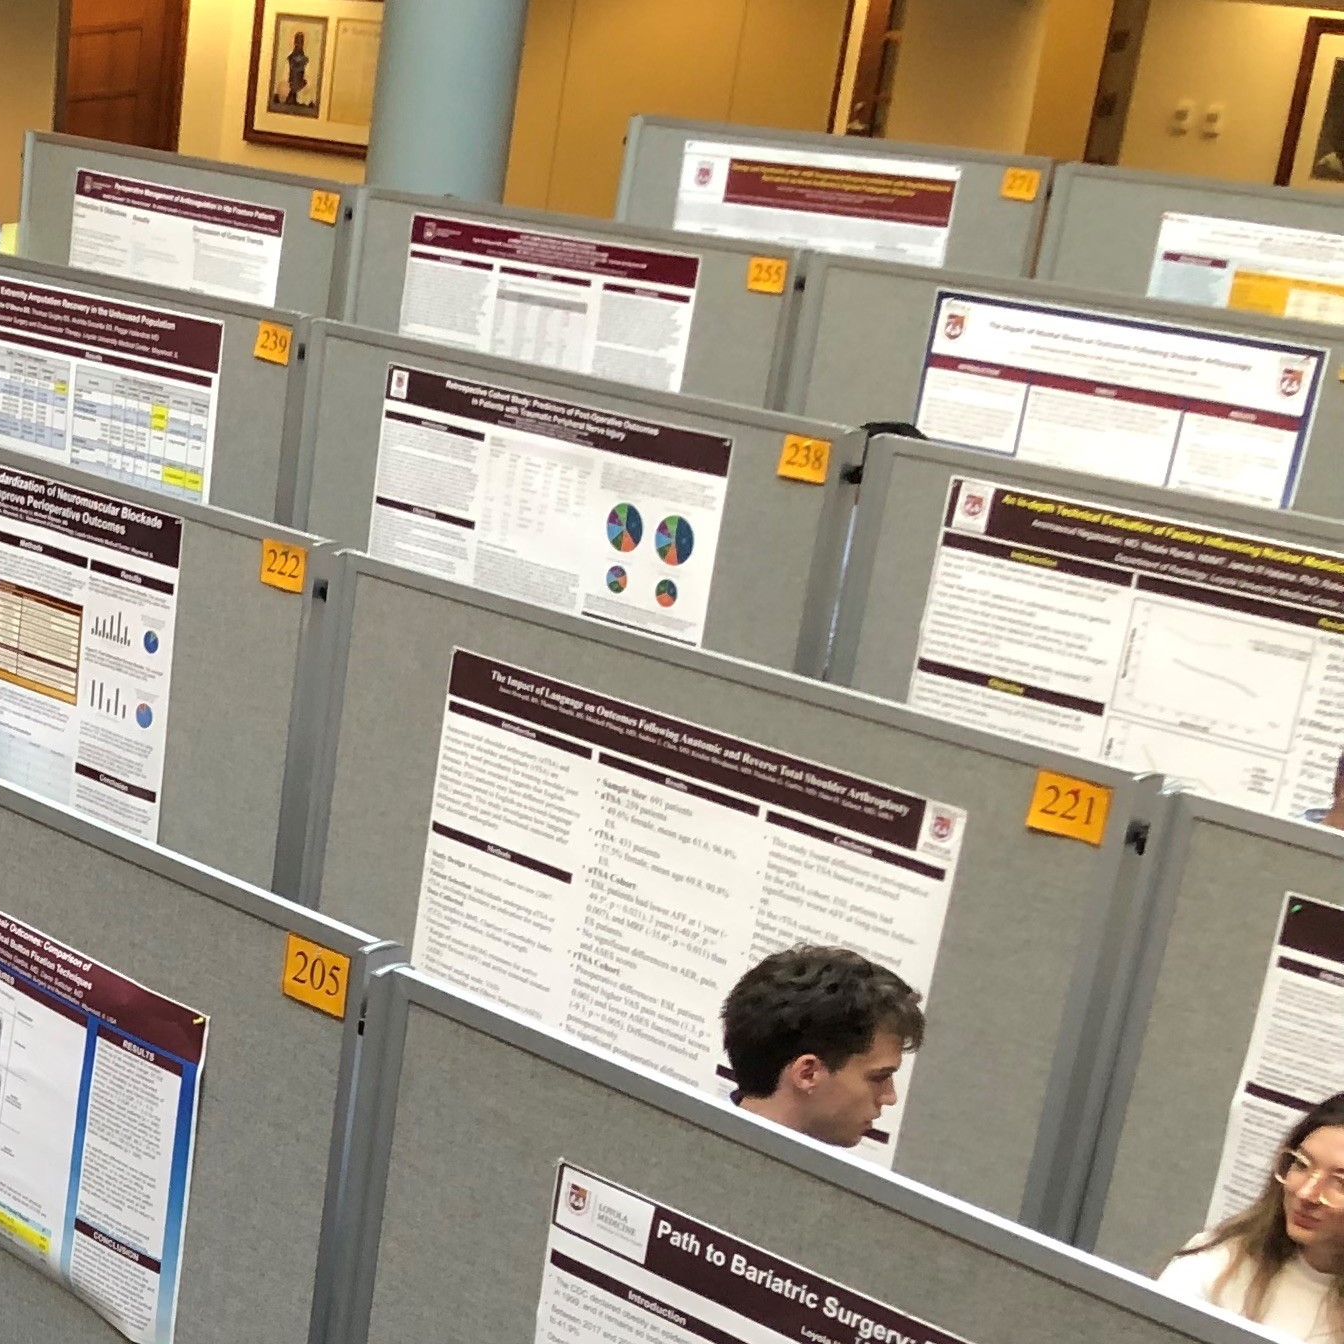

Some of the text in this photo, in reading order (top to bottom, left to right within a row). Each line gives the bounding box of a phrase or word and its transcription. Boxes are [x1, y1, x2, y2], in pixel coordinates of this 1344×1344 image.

[754, 263, 782, 283] 255
[0, 286, 27, 301] Extremity
[28, 292, 61, 306] Amputation
[62, 299, 90, 314] Recovery
[97, 306, 107, 316] the
[141, 315, 175, 330] Population
[260, 331, 287, 353] 239
[478, 398, 504, 411] Patients
[505, 405, 519, 414] with
[520, 407, 552, 422] Traumatic
[552, 414, 585, 430] Peripheral
[585, 423, 605, 434] Nerve
[605, 427, 625, 441] Injury
[488, 389, 509, 401] Cohort
[532, 399, 565, 414] Predictors
[785, 443, 825, 471] 238
[27, 495, 80, 521] Perioperative
[82, 511, 125, 535] Outcomes
[47, 487, 55, 497] of
[57, 488, 119, 516] Neuromuscular
[121, 507, 162, 528] Blockade
[267, 549, 300, 579] 222
[492, 670, 909, 816] The Impact of Language on Outcomes Following Anatomic and Reverse Total Shoulder Arthroplasty
[1040, 785, 1094, 825] 221
[9, 923, 43, 947] Outcomes:
[43, 941, 81, 967] Comparison
[82, 963, 91, 972] of
[9, 938, 29, 956] Button
[31, 950, 55, 970] Fixation
[56, 963, 92, 990] Techniques
[292, 951, 342, 1000] 205
[122, 1039, 154, 1061] RESULTS
[599, 1203, 629, 1222] LOYOLA
[93, 1231, 139, 1261] CONCLUSION
[657, 1220, 700, 1255] Path
[705, 1245, 725, 1266] to
[731, 1254, 818, 1308] Bariatric
[628, 1290, 686, 1325] Introduction
